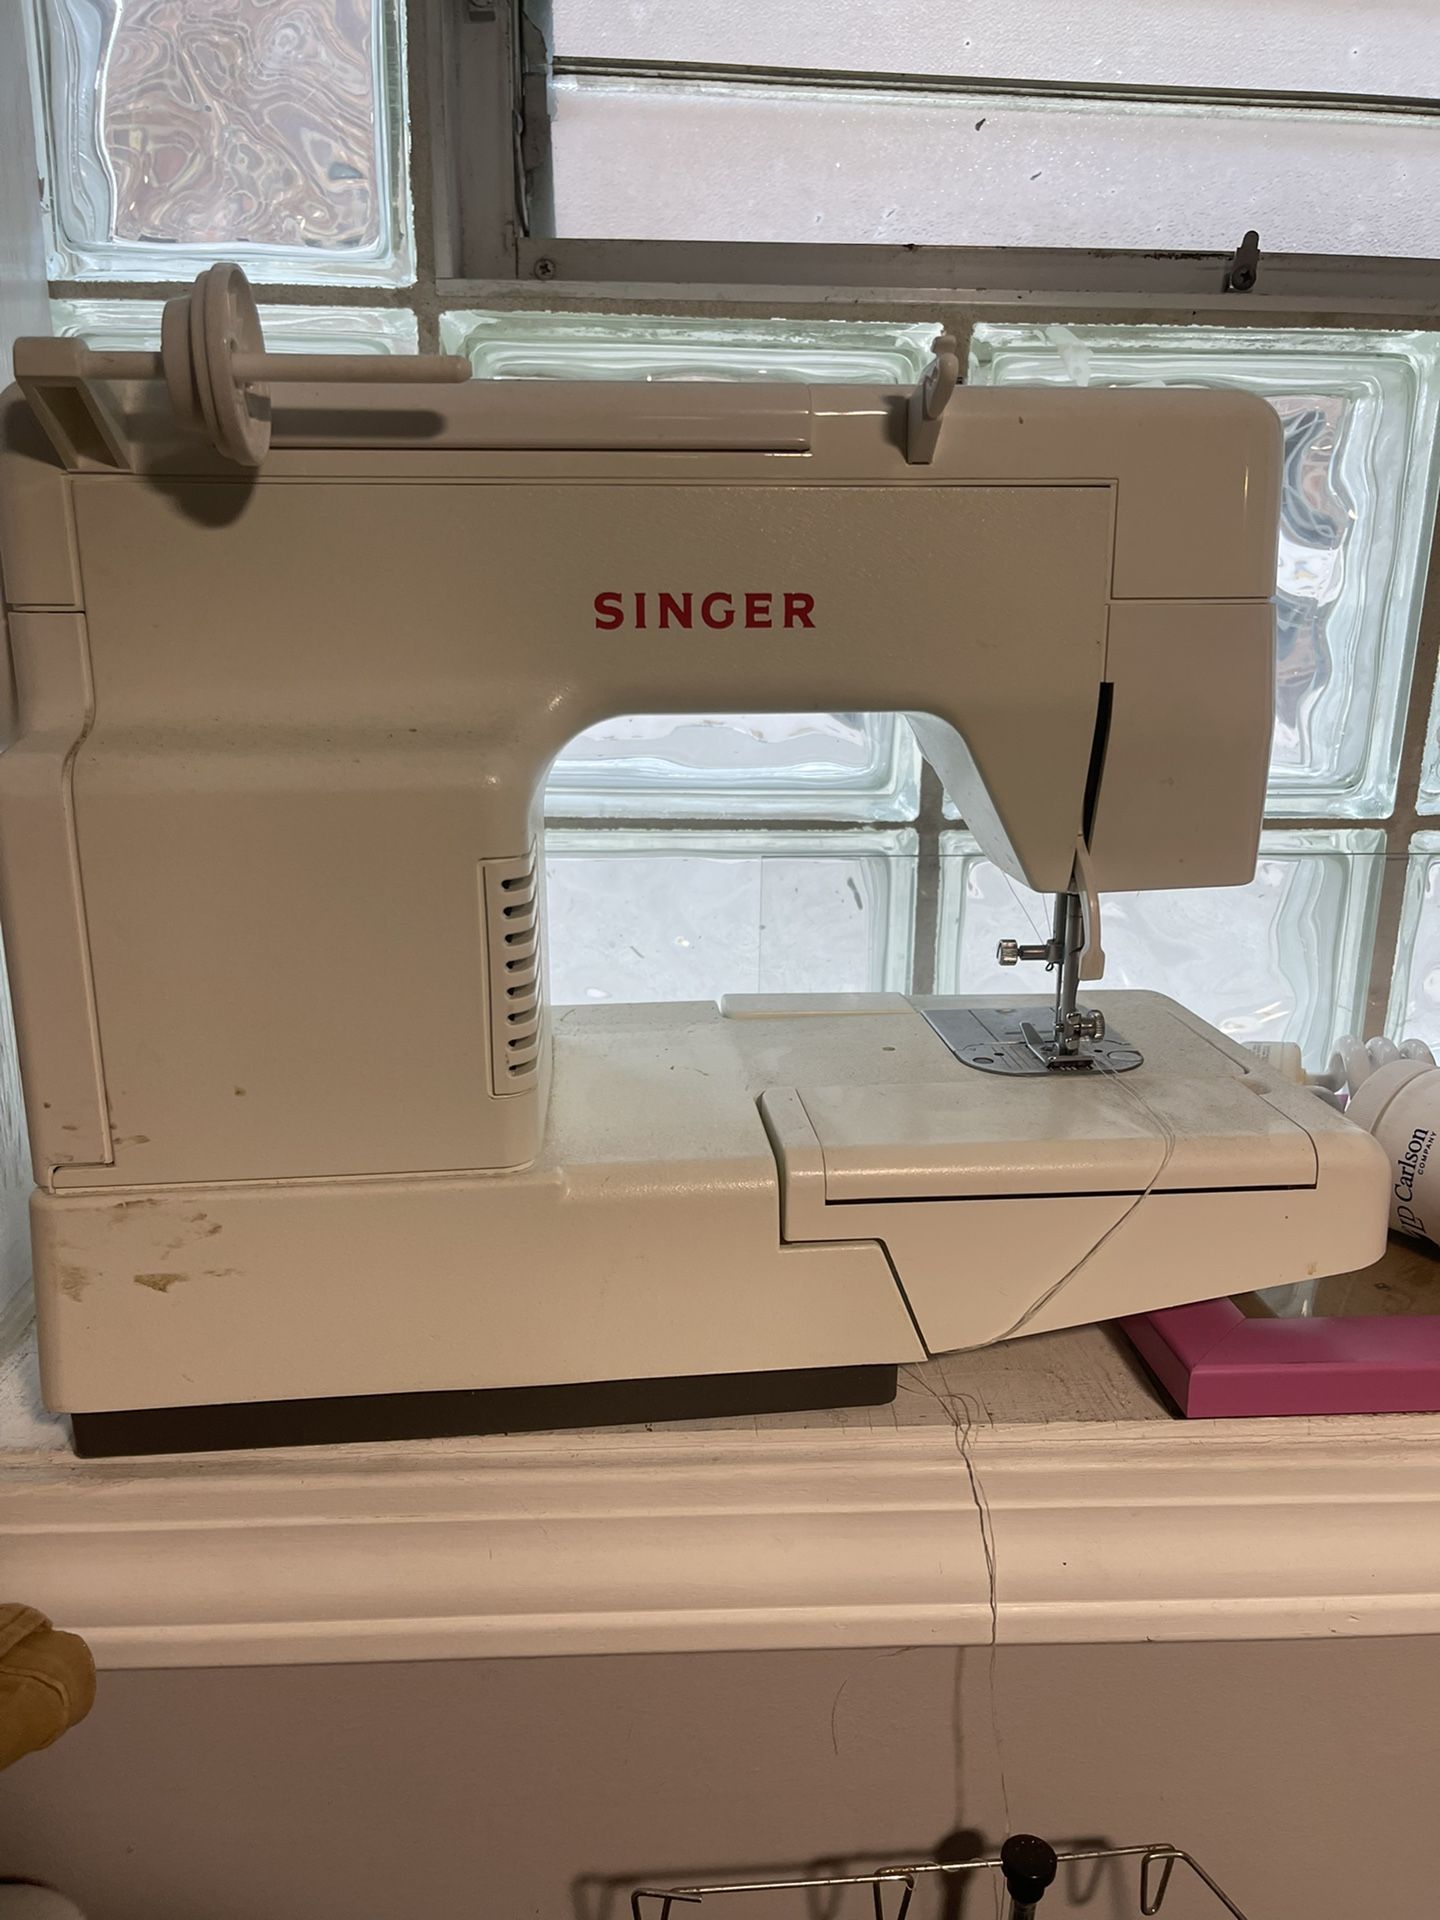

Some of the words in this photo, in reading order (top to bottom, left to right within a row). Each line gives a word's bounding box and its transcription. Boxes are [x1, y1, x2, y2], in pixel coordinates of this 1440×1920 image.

[593, 591, 816, 630] SINGER
[1394, 1128, 1428, 1202] Carlson
[1417, 1131, 1437, 1175] COMPANY
